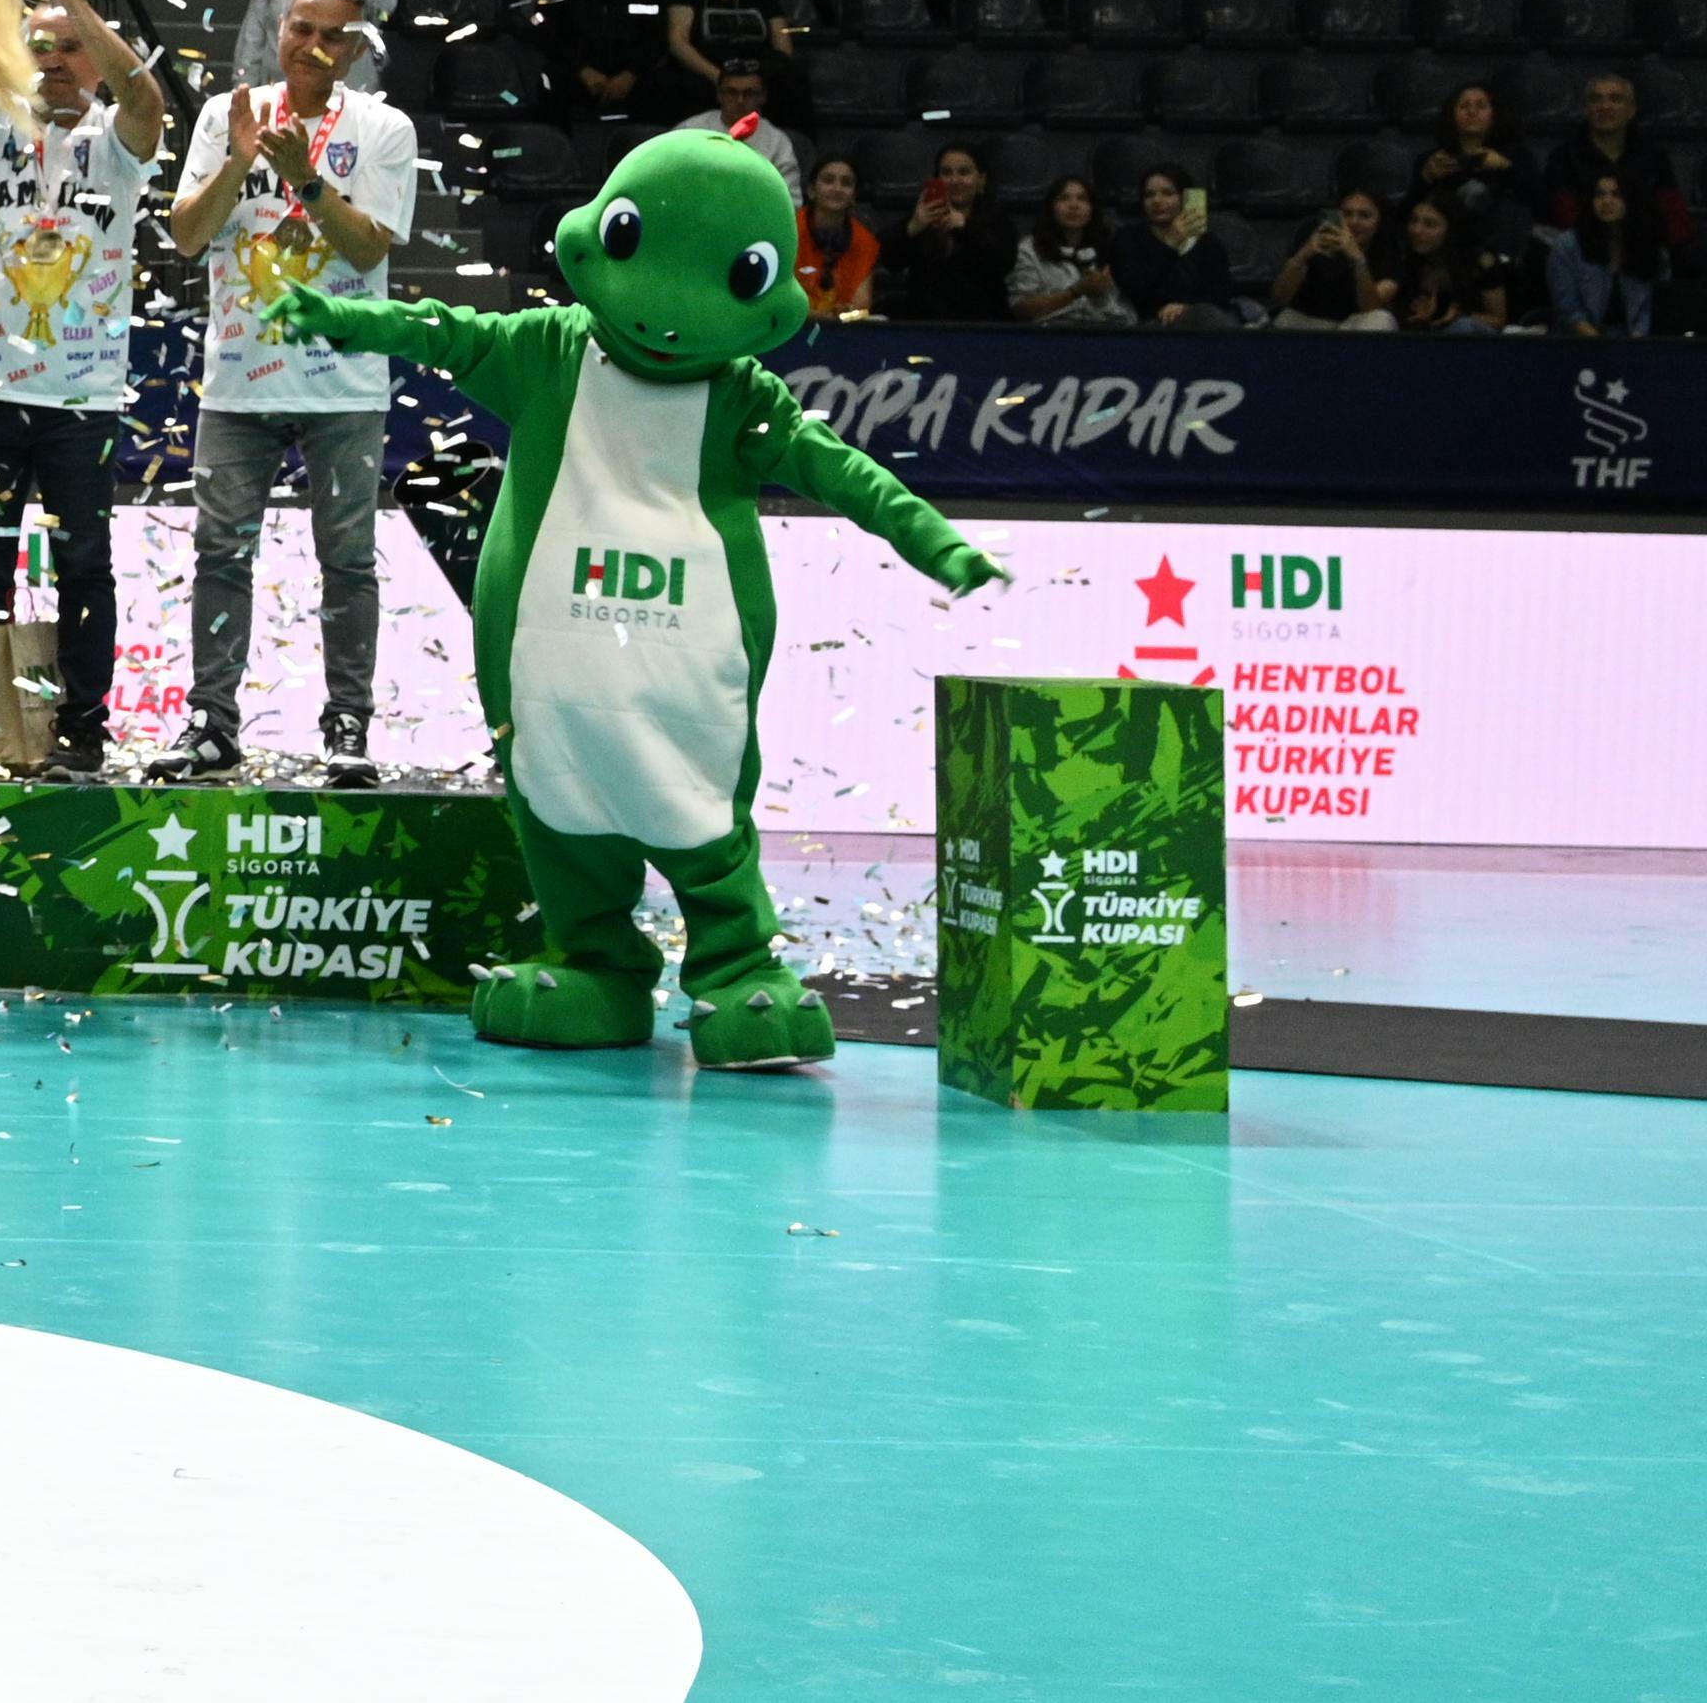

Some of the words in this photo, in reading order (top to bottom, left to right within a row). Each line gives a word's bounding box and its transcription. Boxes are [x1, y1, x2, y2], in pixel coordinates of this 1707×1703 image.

[969, 376, 1245, 456] KADAR
[1571, 457, 1653, 489] THF
[573, 547, 685, 606] HDI
[1231, 553, 1342, 611] HDI
[1234, 663, 1405, 694] HENTBOL
[1234, 704, 1419, 736] KADINLAR
[1234, 737, 1396, 775] TÜRKİYE
[1235, 785, 1370, 816] KUPASI
[227, 813, 322, 856] HDI
[227, 856, 321, 876] SİGORTA
[959, 838, 980, 864] HDI
[1083, 850, 1138, 874] HDI
[224, 887, 432, 934] TÜRKİYE
[1082, 891, 1201, 919] TÜRKİYE
[1082, 923, 1186, 945] KUPASI
[223, 942, 404, 979] KUPASI
